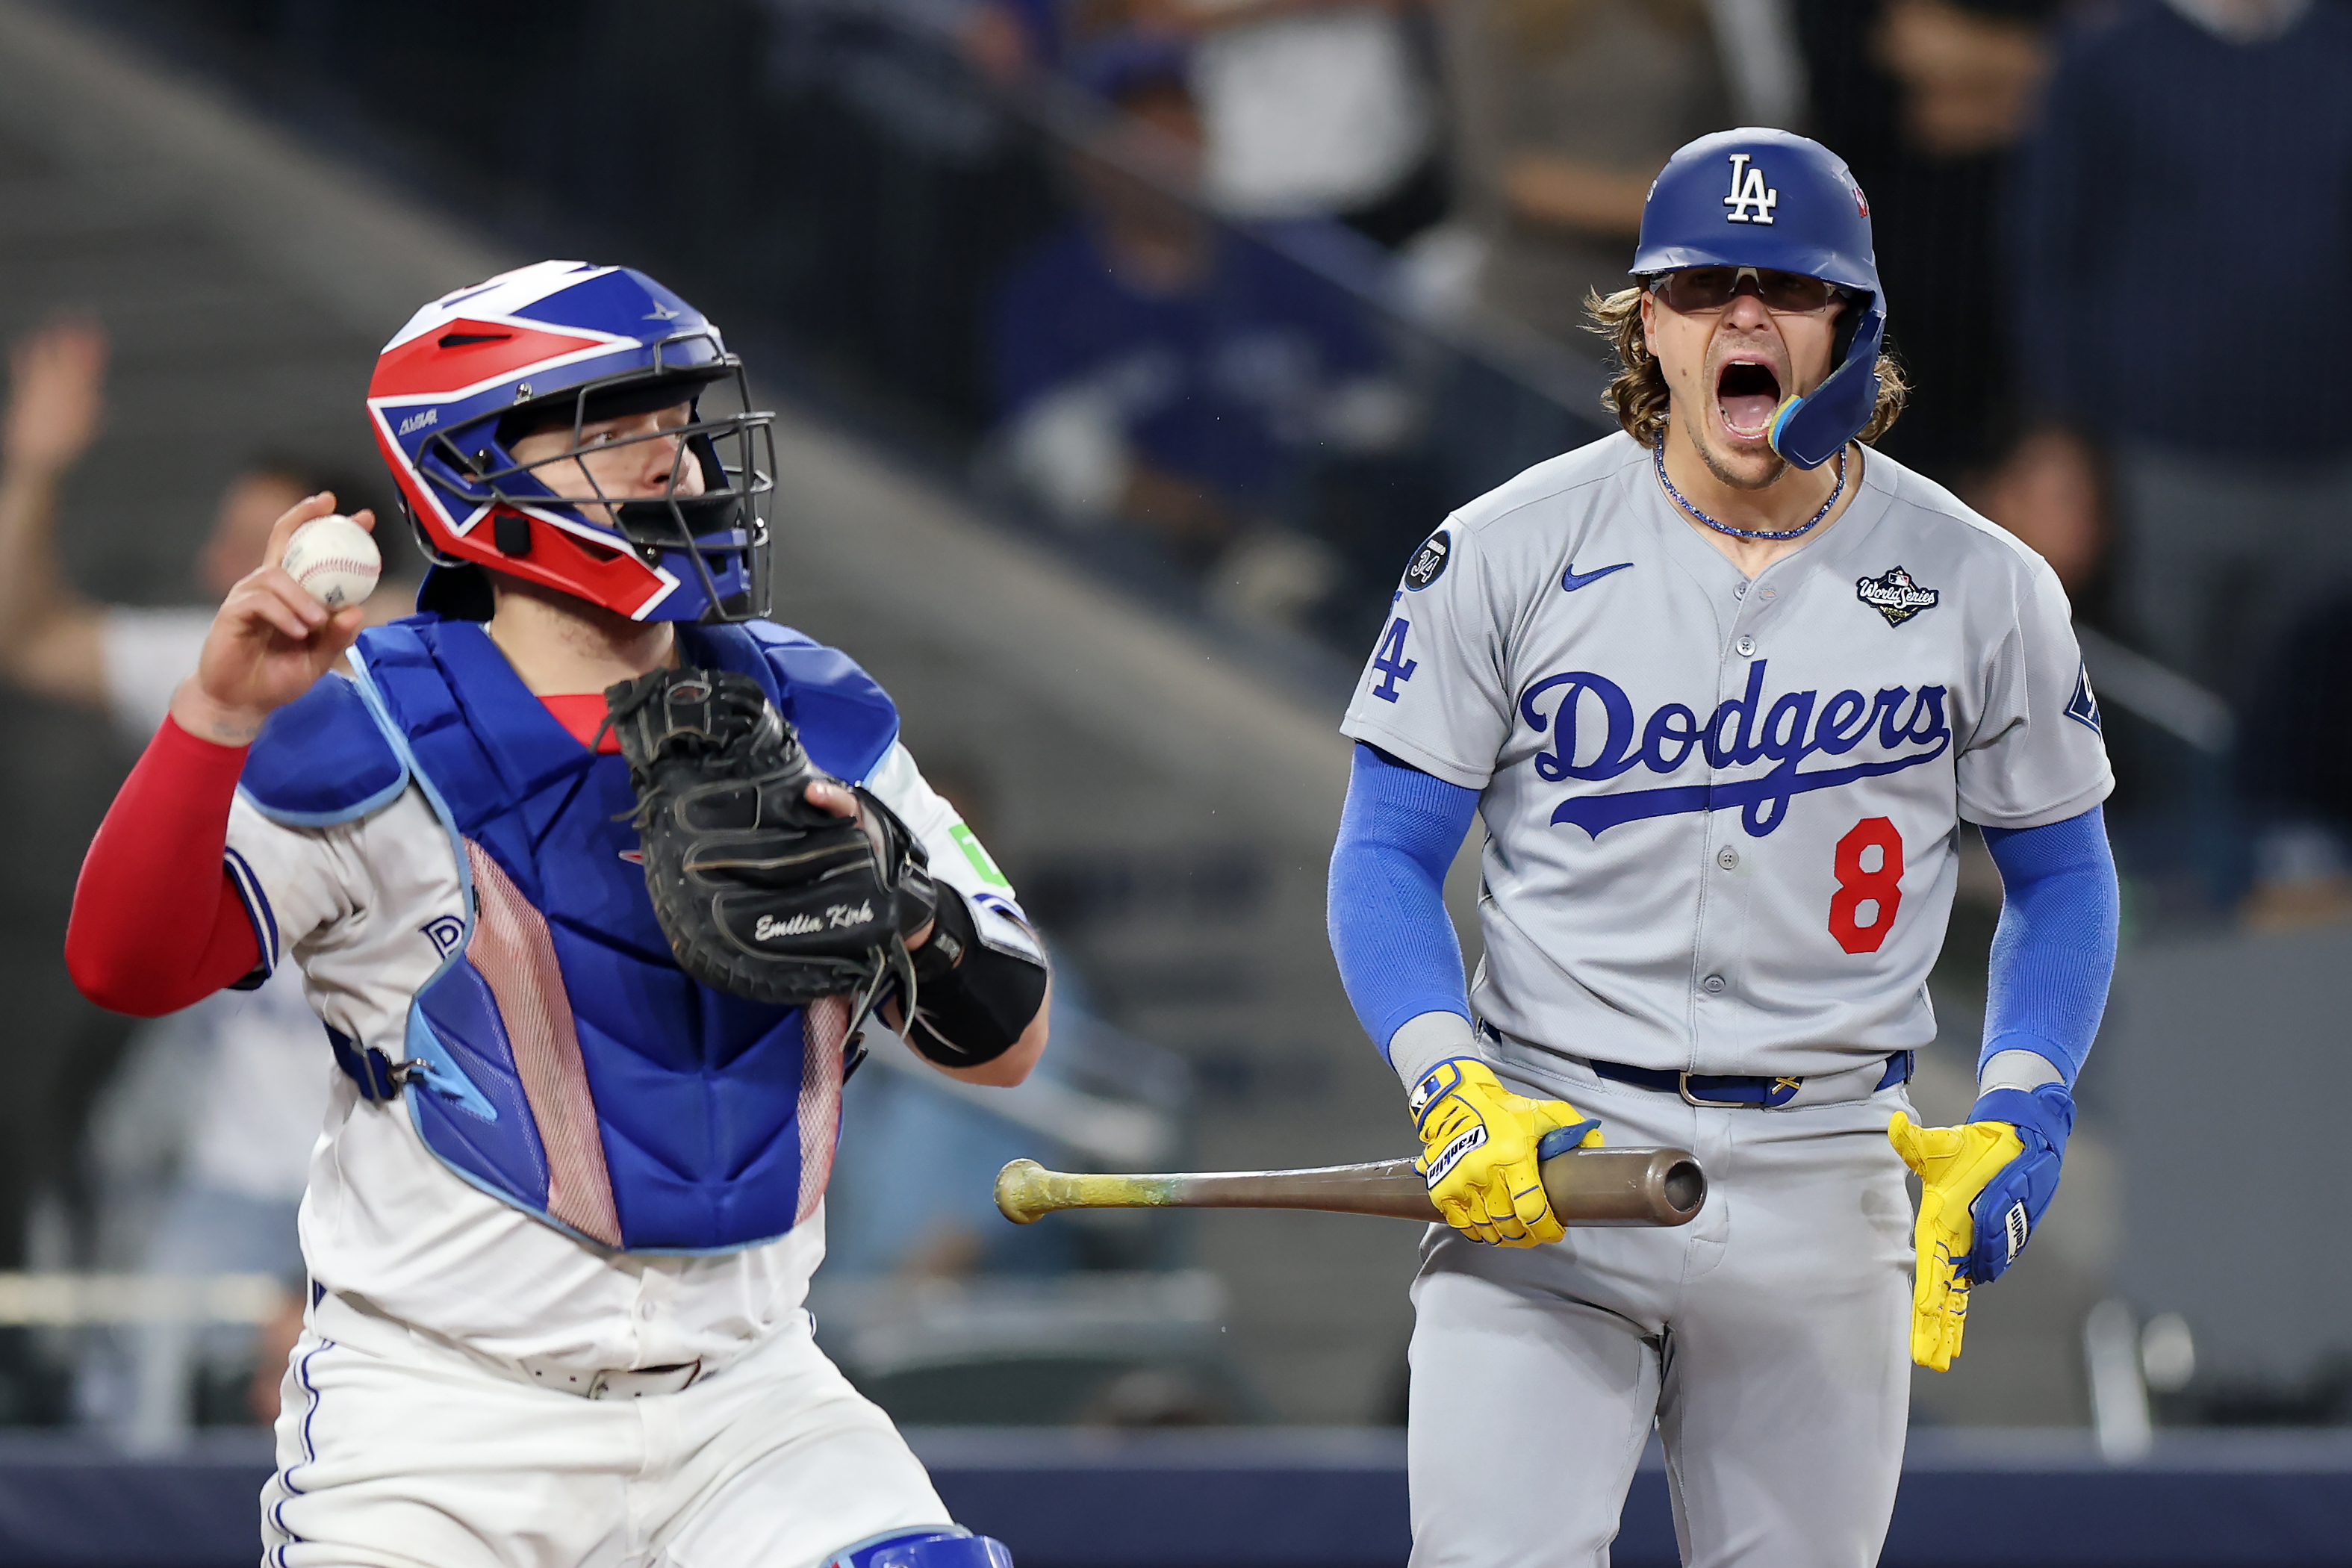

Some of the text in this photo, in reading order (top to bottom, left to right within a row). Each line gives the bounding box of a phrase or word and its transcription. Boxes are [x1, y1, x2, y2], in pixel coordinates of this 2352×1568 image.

[1723, 153, 1778, 225] LA
[1410, 550, 1440, 583] 34
[1859, 579, 1935, 609] World Series
[1520, 660, 1950, 837] Dodgers
[1828, 816, 1904, 954] 8
